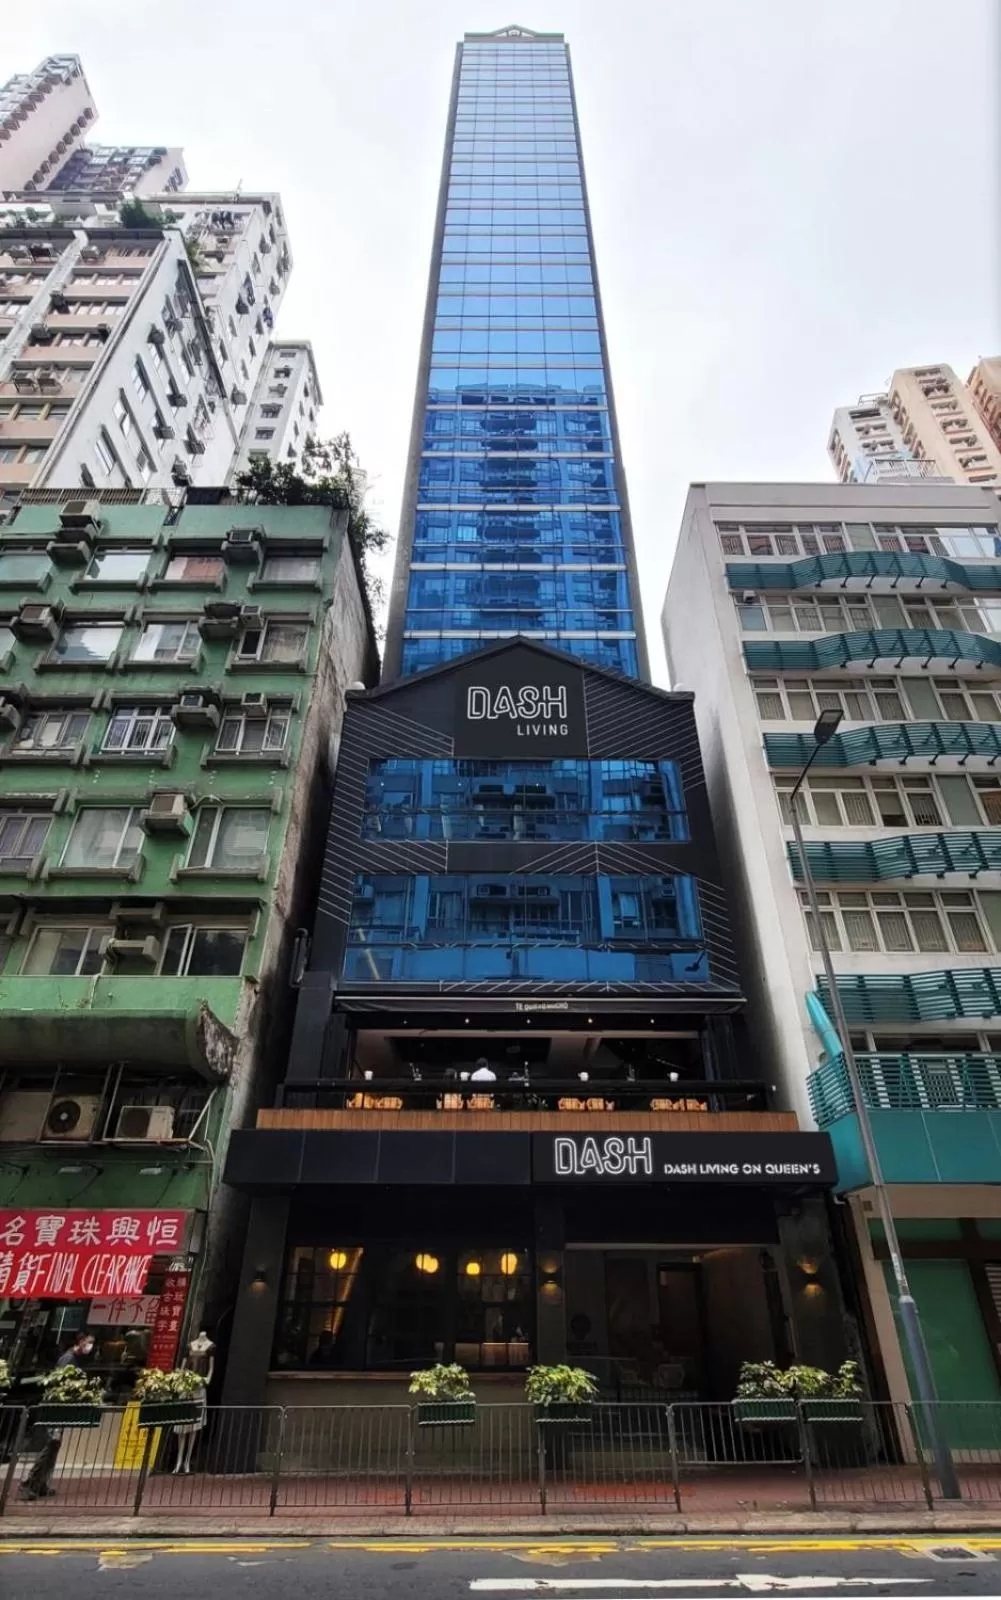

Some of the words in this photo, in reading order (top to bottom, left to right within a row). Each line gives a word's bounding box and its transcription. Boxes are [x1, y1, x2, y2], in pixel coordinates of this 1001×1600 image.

[467, 686, 567, 719] DASH
[517, 724, 568, 736] LIVING
[554, 1137, 653, 1175] DASH
[664, 1163, 697, 1175] DASH
[700, 1163, 739, 1175] LIVING
[742, 1163, 762, 1175] ON
[765, 1163, 820, 1175] QUEEN'S
